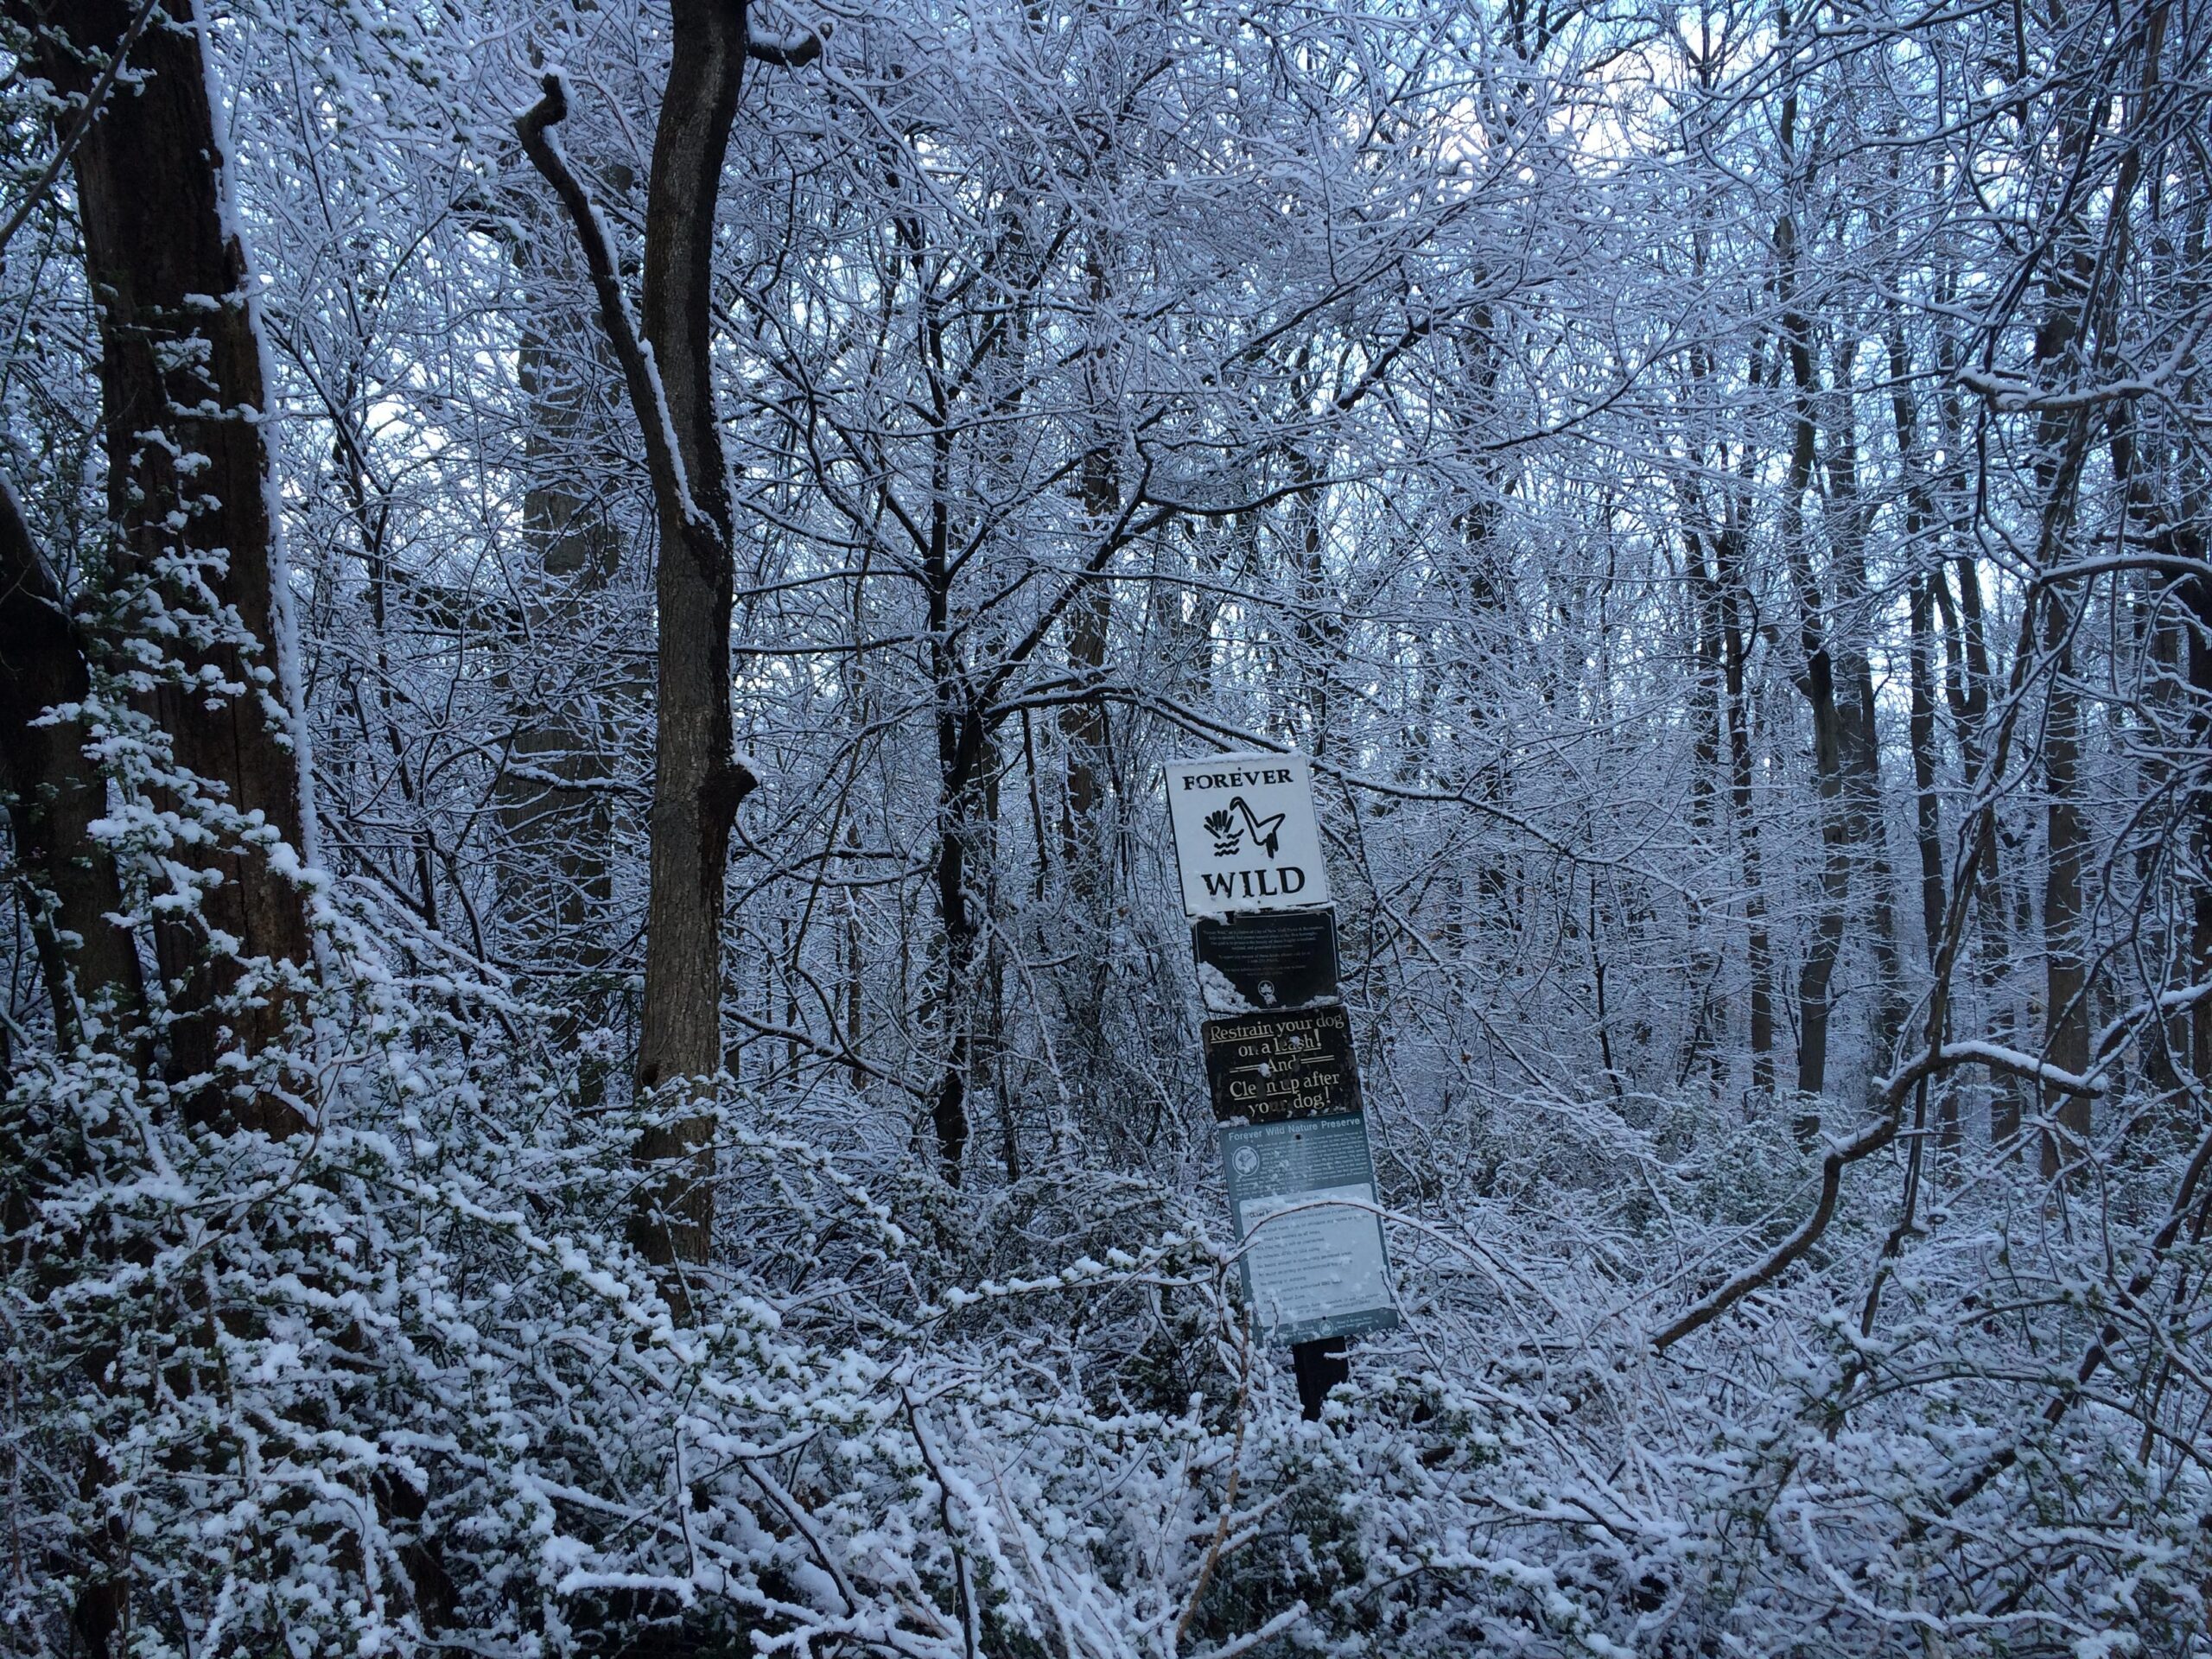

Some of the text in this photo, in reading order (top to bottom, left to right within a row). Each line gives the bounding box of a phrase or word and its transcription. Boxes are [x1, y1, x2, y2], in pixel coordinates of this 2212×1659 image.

[1182, 769, 1294, 791] FOREVER
[1201, 867, 1306, 899] WILD
[1211, 1014, 1344, 1041] Restrain your dog
[1262, 1042, 1271, 1054] a
[1230, 1081, 1279, 1098] Clen
[1303, 1071, 1339, 1088] after
[1294, 1086, 1331, 1109] dog!
[1229, 1117, 1361, 1141] Forever Wild Nature Preserve
